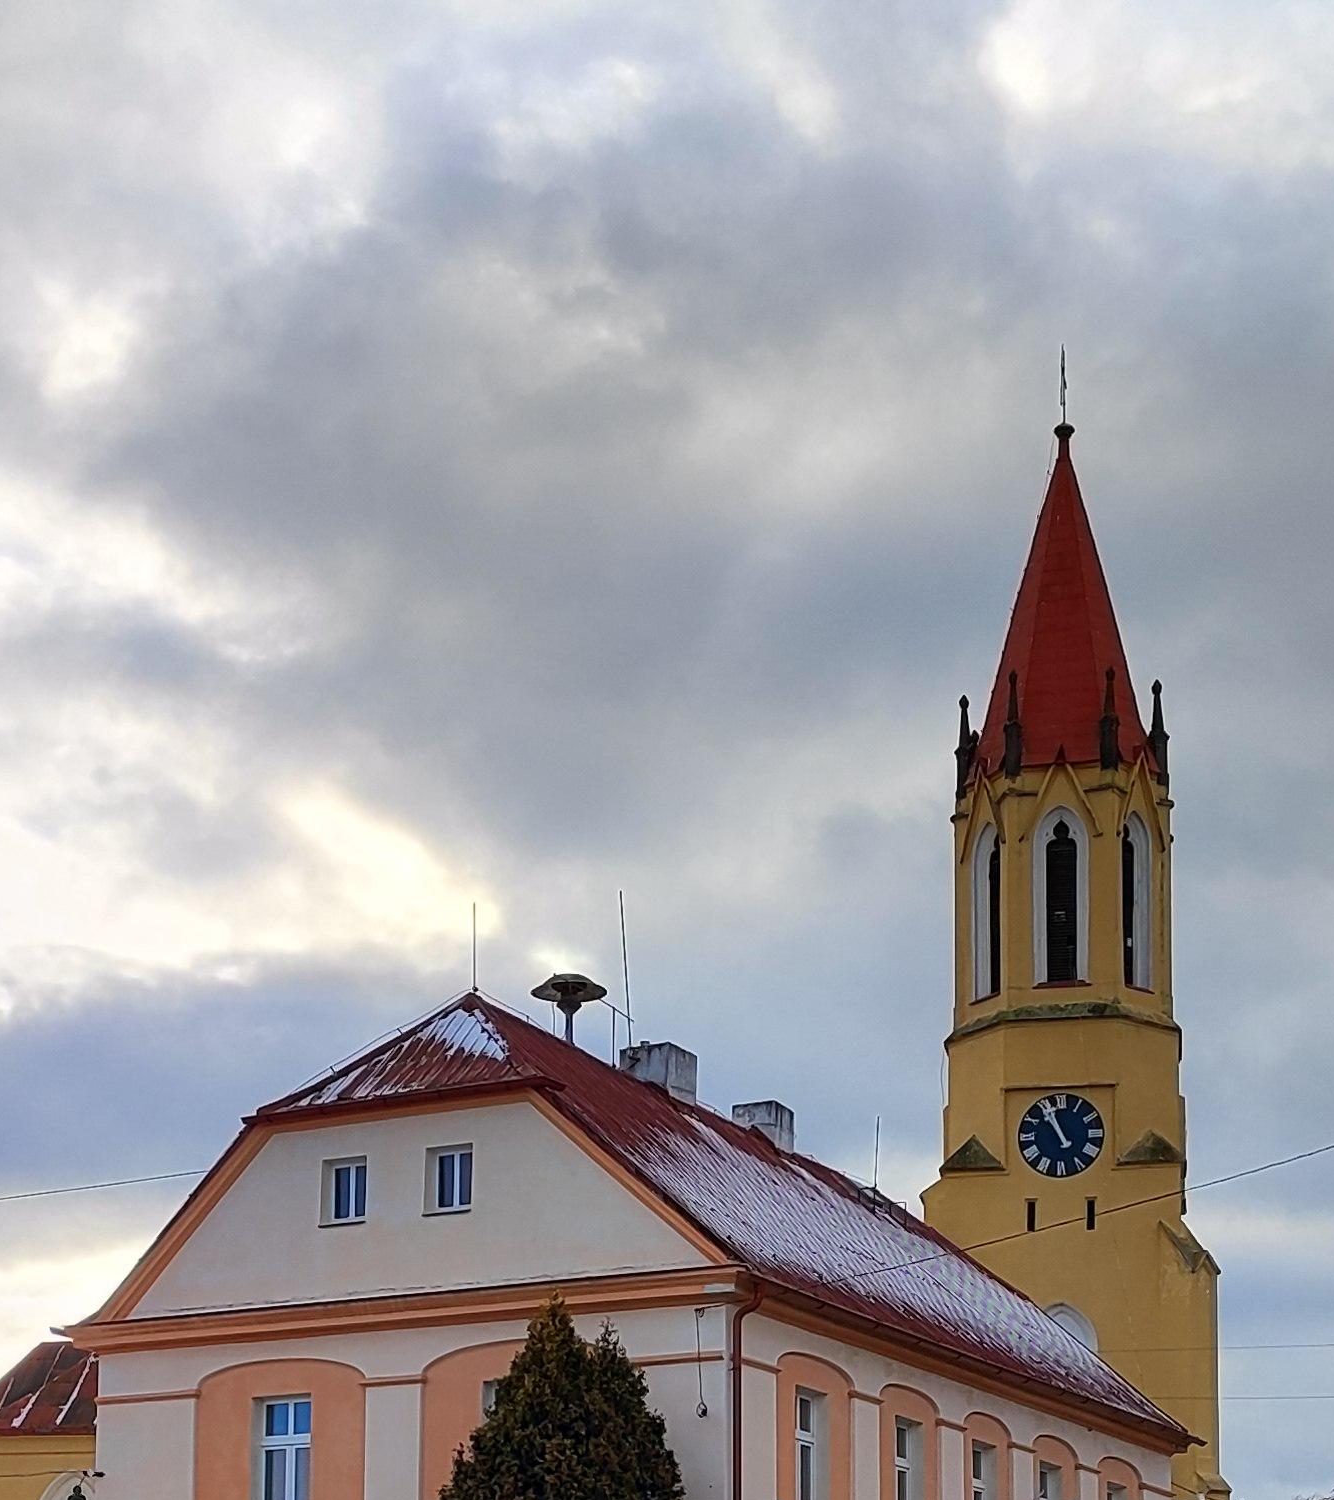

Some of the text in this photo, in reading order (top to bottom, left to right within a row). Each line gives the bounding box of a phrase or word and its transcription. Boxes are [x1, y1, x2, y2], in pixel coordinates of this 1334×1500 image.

[1024, 1114, 1040, 1125] X
[1083, 1111, 1098, 1124] II
[1088, 1129, 1103, 1138] III
[1074, 1157, 1086, 1171] V
